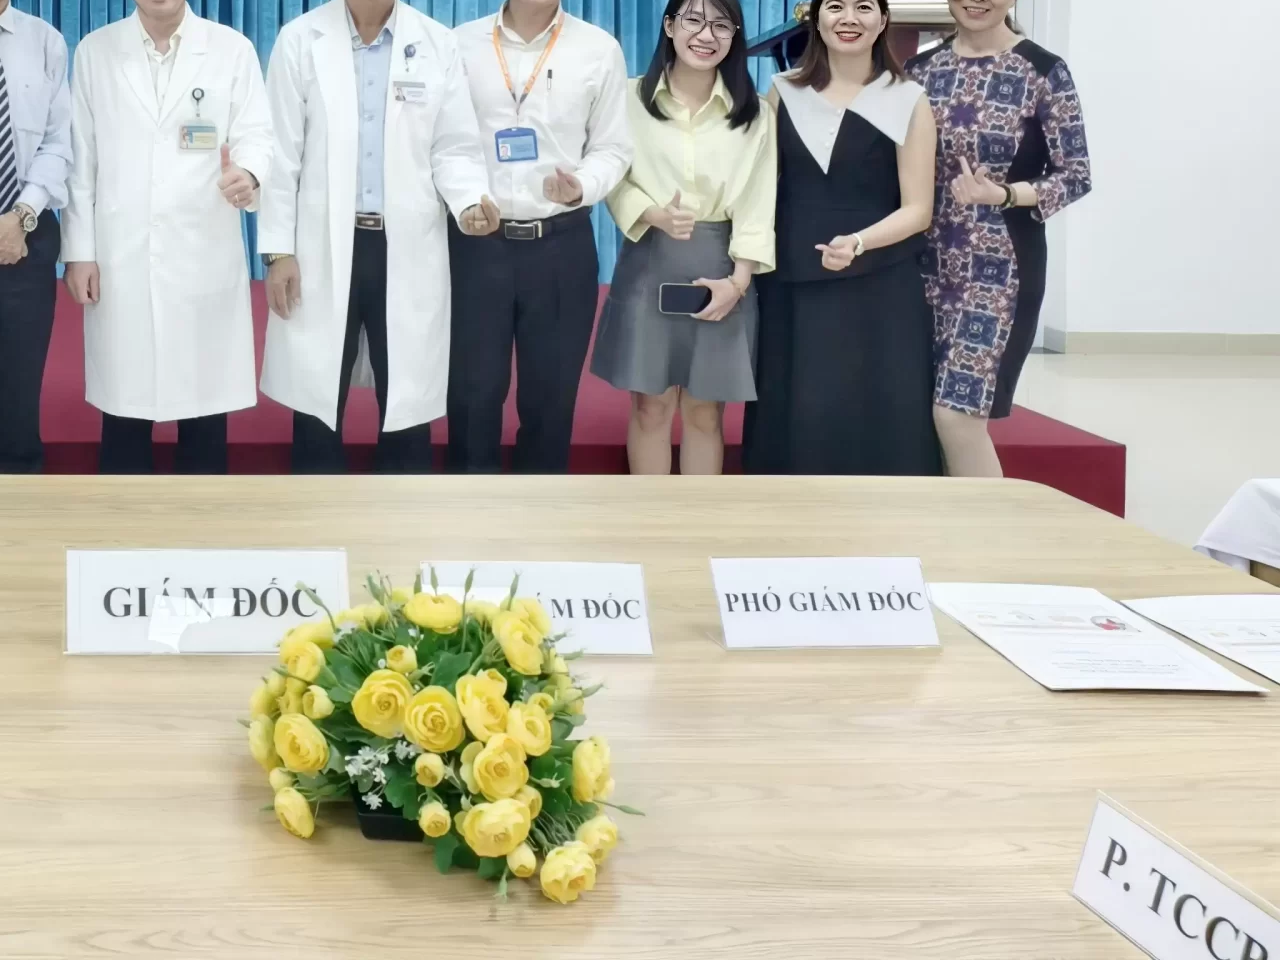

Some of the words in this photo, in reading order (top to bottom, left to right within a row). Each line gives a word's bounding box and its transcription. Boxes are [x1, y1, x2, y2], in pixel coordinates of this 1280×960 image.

[231, 577, 318, 618] ĐỐC
[580, 592, 641, 620] ĐỐC
[724, 585, 781, 613] PHÓ
[789, 585, 862, 612] GIÁM
[868, 585, 925, 612] ĐỐC
[1099, 835, 1131, 892] P.
